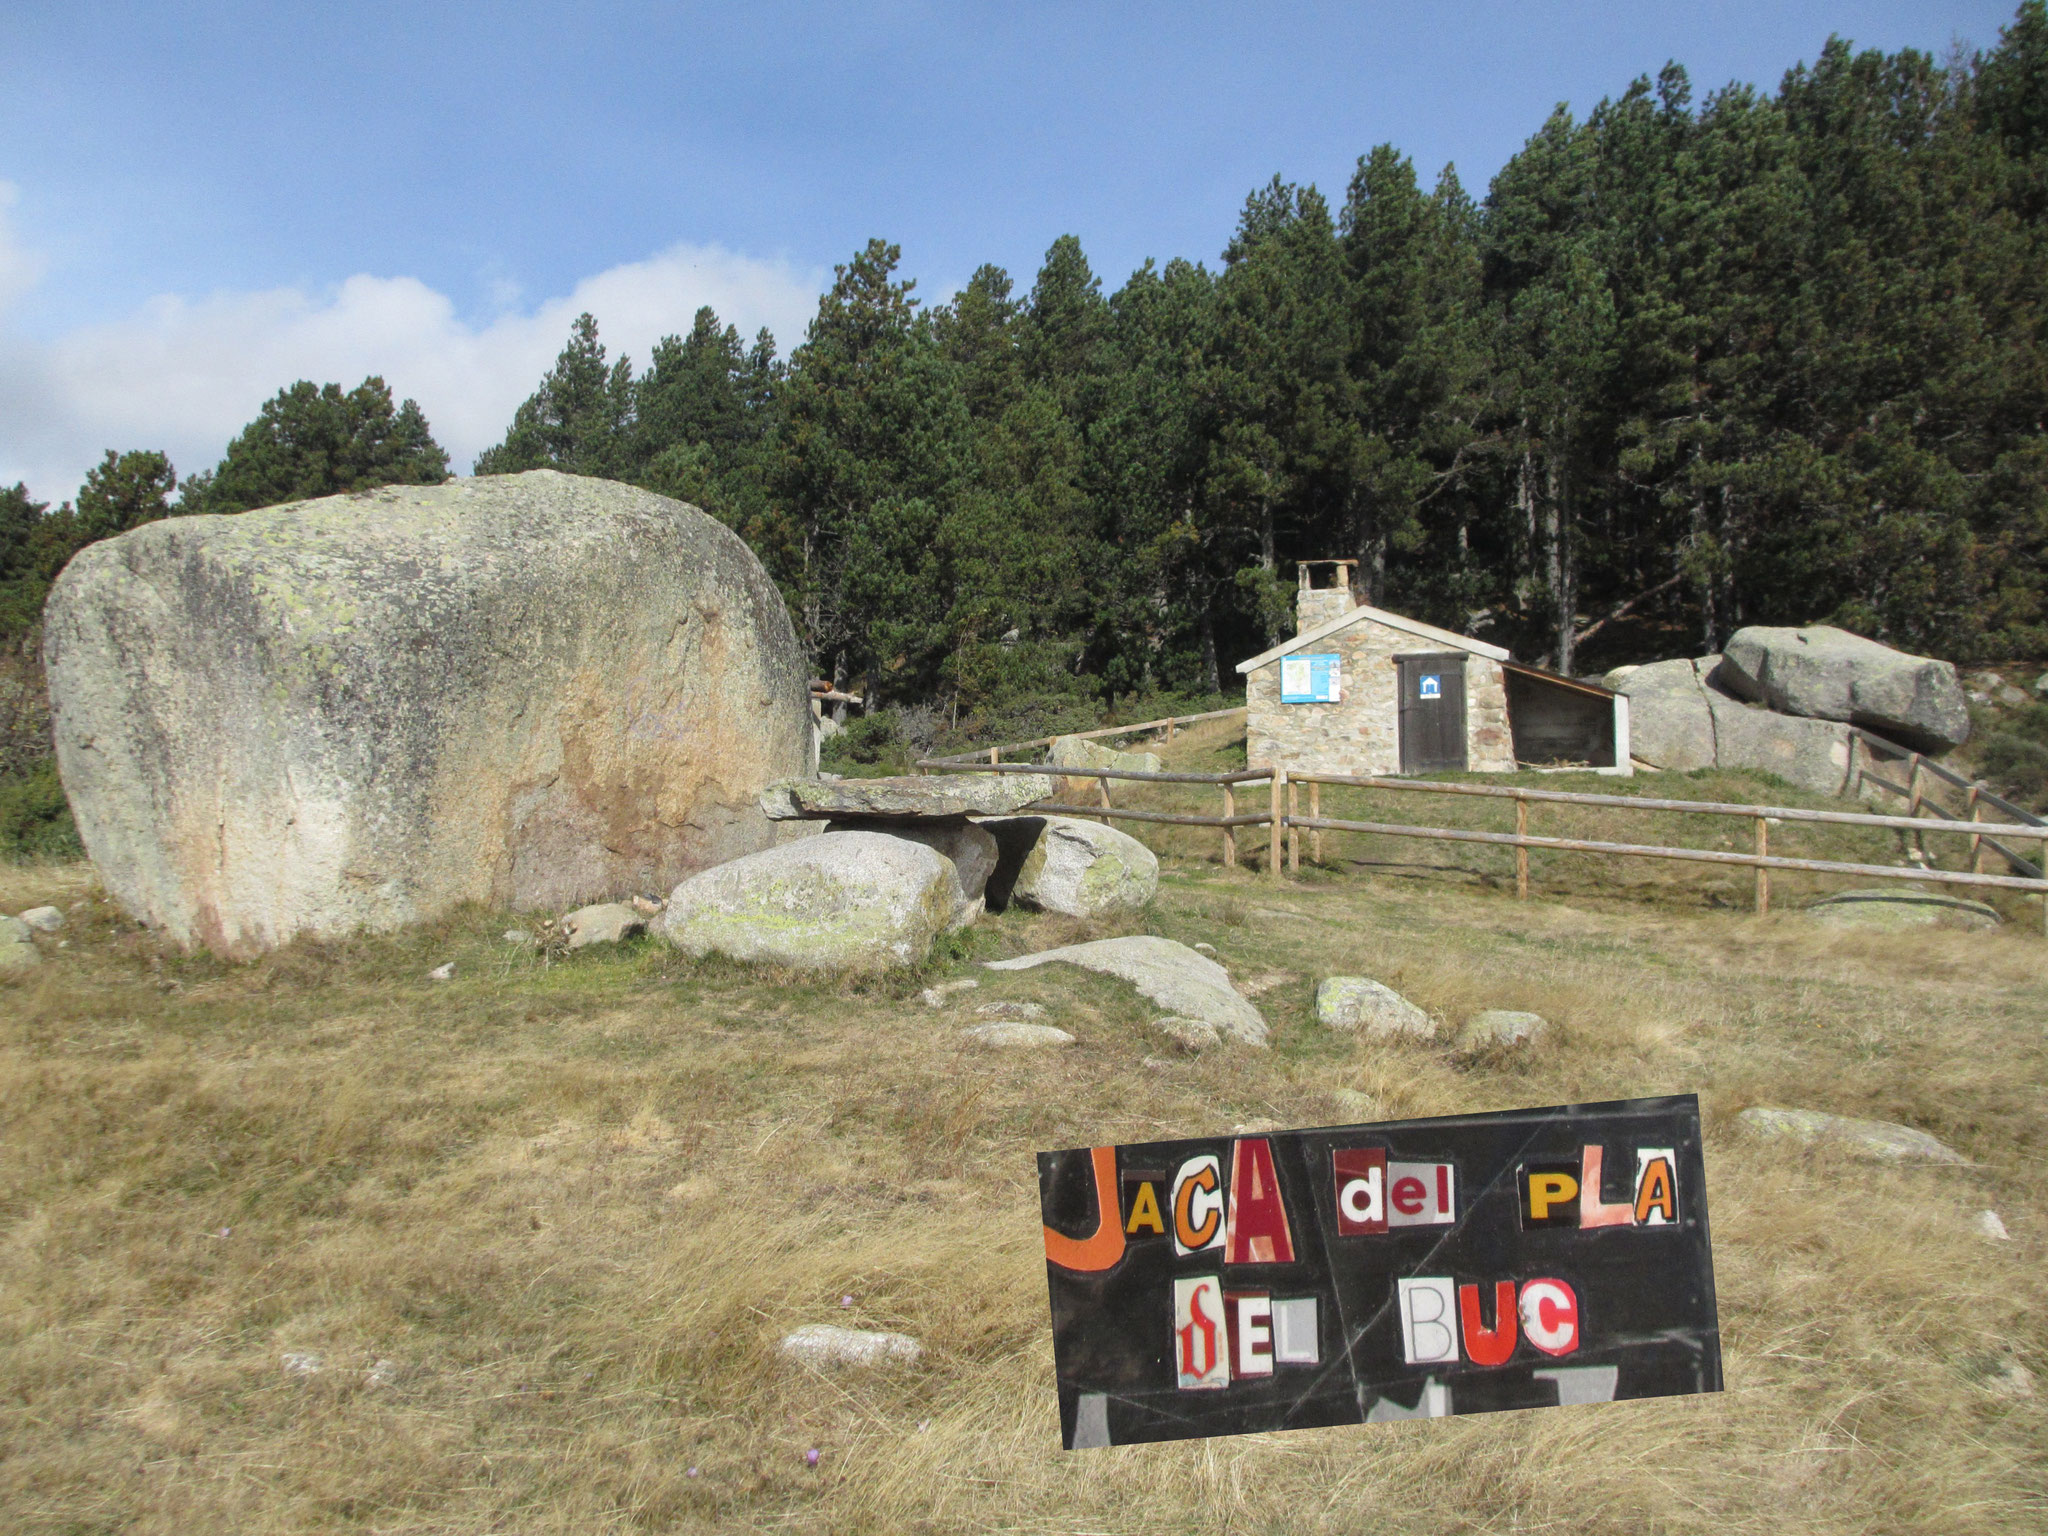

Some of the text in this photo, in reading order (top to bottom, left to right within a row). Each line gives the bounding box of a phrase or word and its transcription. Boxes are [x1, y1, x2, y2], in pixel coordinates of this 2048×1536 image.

[1045, 1138, 1677, 1272] JACA del PLA
[1408, 1281, 1576, 1366] BUC
